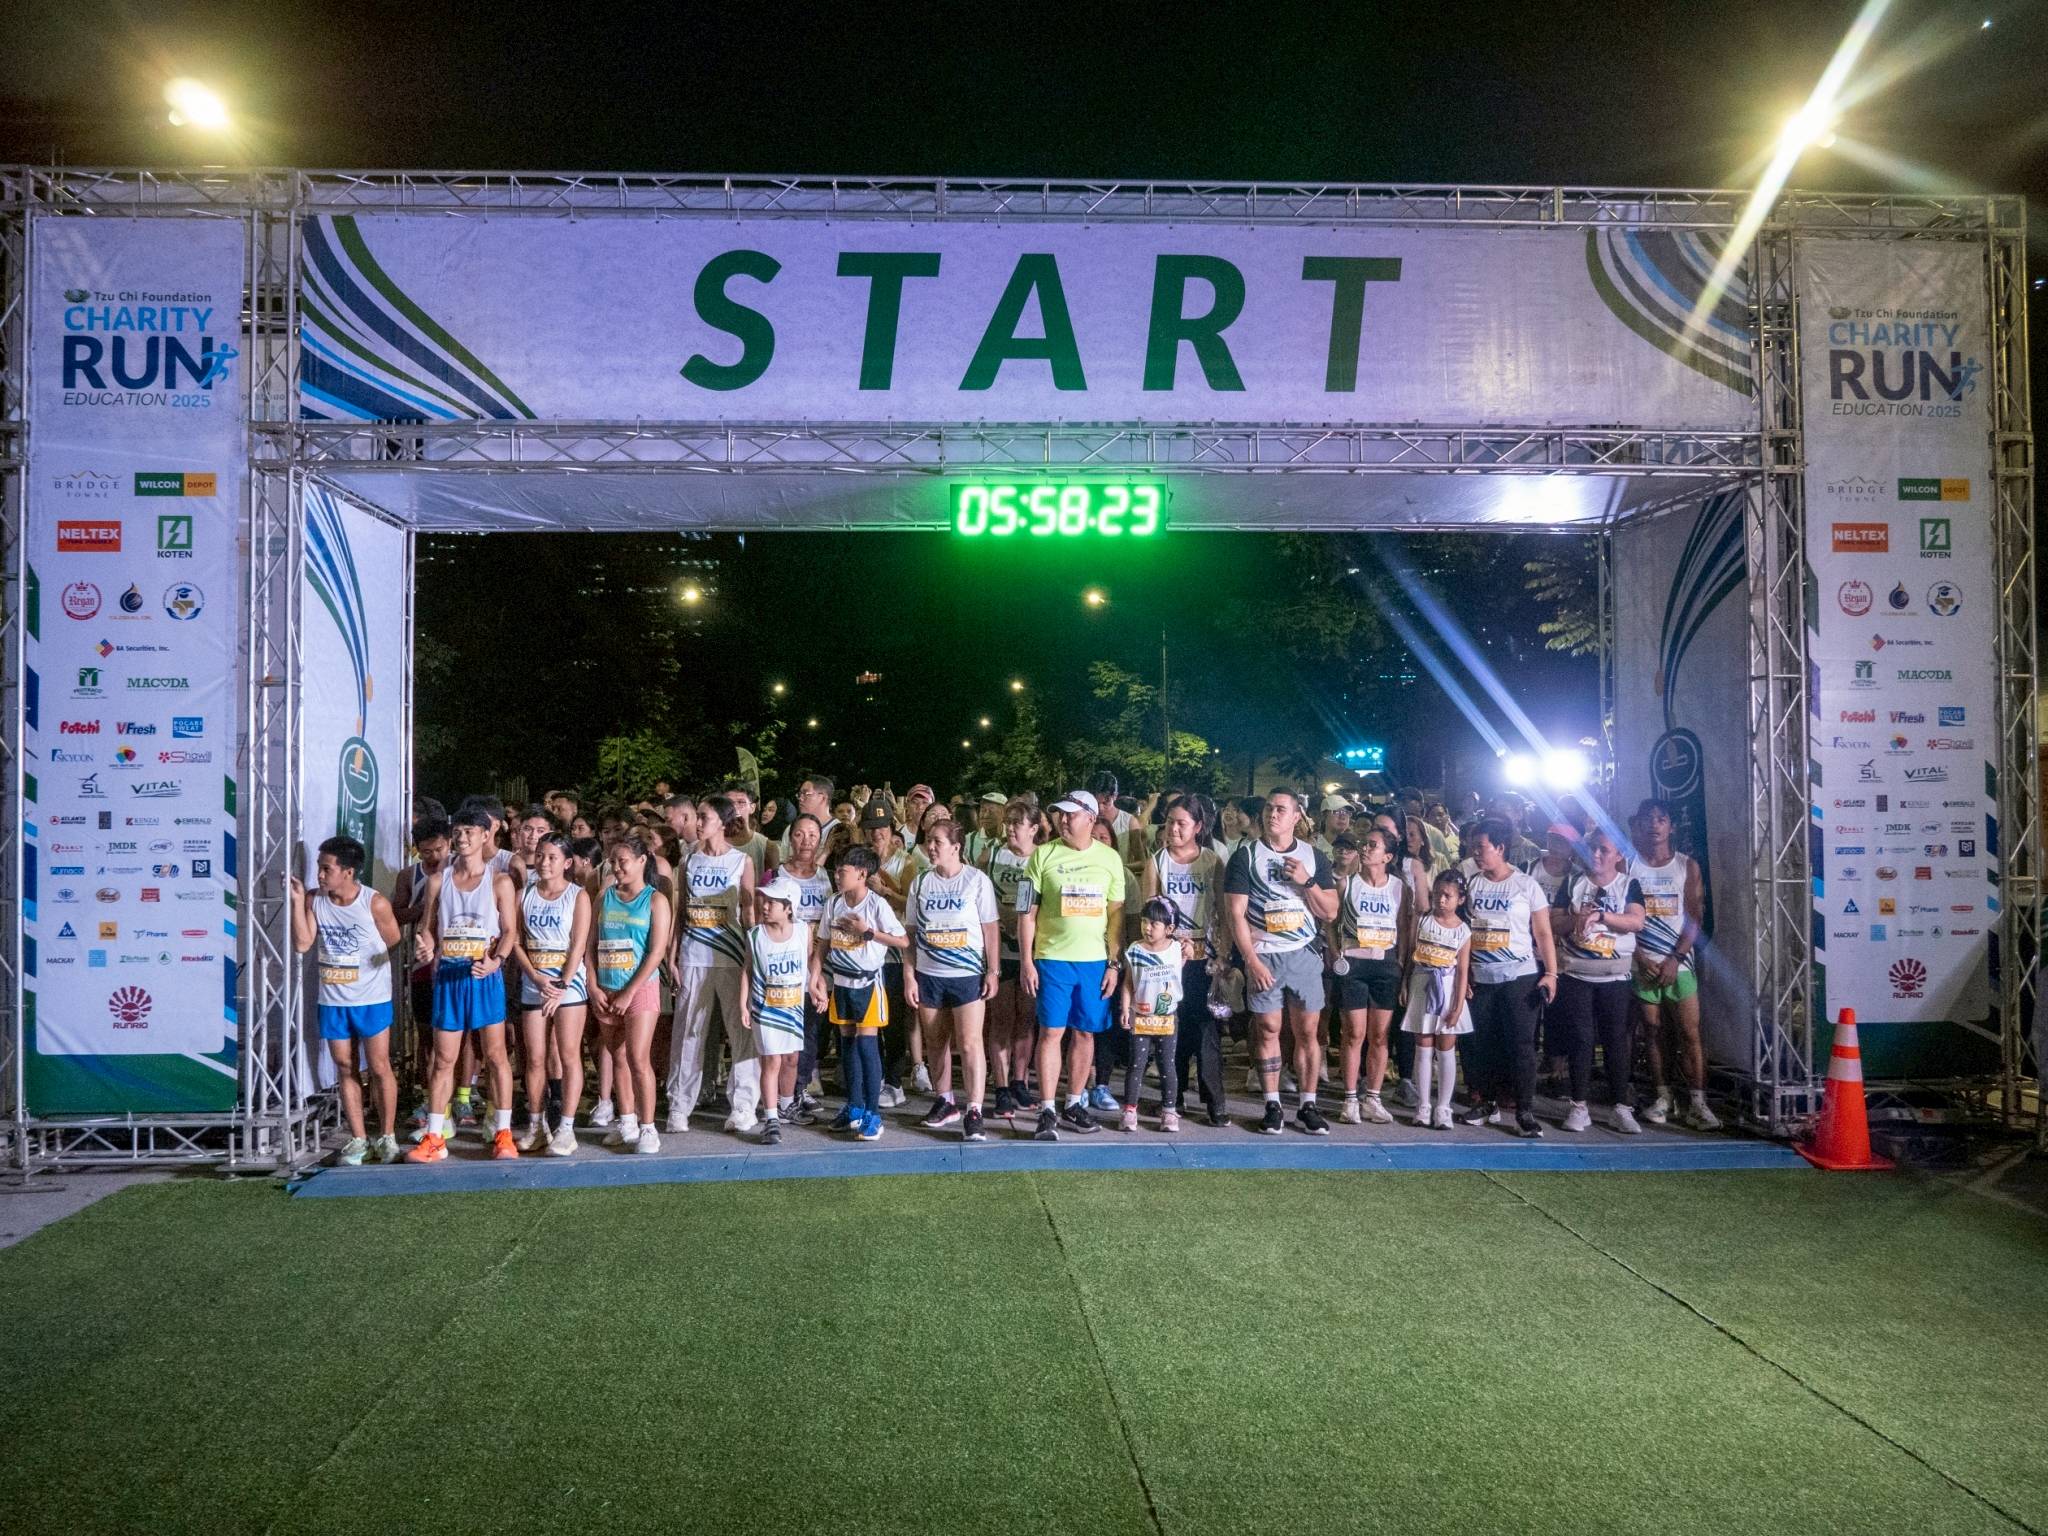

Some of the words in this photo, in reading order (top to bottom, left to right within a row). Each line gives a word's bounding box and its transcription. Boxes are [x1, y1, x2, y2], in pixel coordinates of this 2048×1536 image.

[94, 292, 115, 302] Tzu
[119, 291, 138, 302] Chi
[141, 291, 212, 303] Foundation
[63, 306, 213, 332] CHARITY
[1856, 309, 1873, 318] Tzu
[1876, 308, 1893, 318] Chi
[1896, 309, 1958, 319] Foundation
[679, 249, 1402, 392] START
[1829, 322, 1960, 347] CHARITY
[62, 336, 214, 390] RUN
[1829, 349, 1962, 402] RUN
[63, 392, 167, 407] EDUCATION
[172, 394, 211, 408] 2025
[1832, 403, 1923, 416] EDUCATION
[1927, 405, 1961, 418] 2025
[54, 479, 120, 490] BRIDGE
[139, 479, 180, 490] WILCON
[187, 481, 214, 489] DEPOT
[1827, 486, 1886, 494] BRIDGE
[60, 528, 119, 539] NELTEX
[1833, 530, 1886, 541] NELTEX
[157, 550, 193, 559] KOTEN
[1920, 551, 1951, 559] KOTEN
[1860, 769, 1881, 779] SL
[1904, 767, 1945, 780] VITAL
[81, 784, 104, 794] SL
[131, 781, 177, 794] VITAL
[1886, 823, 1911, 832] JMDK
[108, 842, 137, 850] JMDK
[692, 874, 728, 889] RUN
[1167, 882, 1204, 895] RUN
[800, 894, 825, 907] UN
[925, 898, 962, 911] RUN
[1472, 898, 1509, 912] RUN
[1359, 901, 1390, 915] RUN
[529, 914, 561, 928] RUN
[931, 934, 962, 943] 00537
[447, 943, 479, 952] 00217
[320, 970, 353, 980] 00218
[769, 960, 801, 977] RUN
